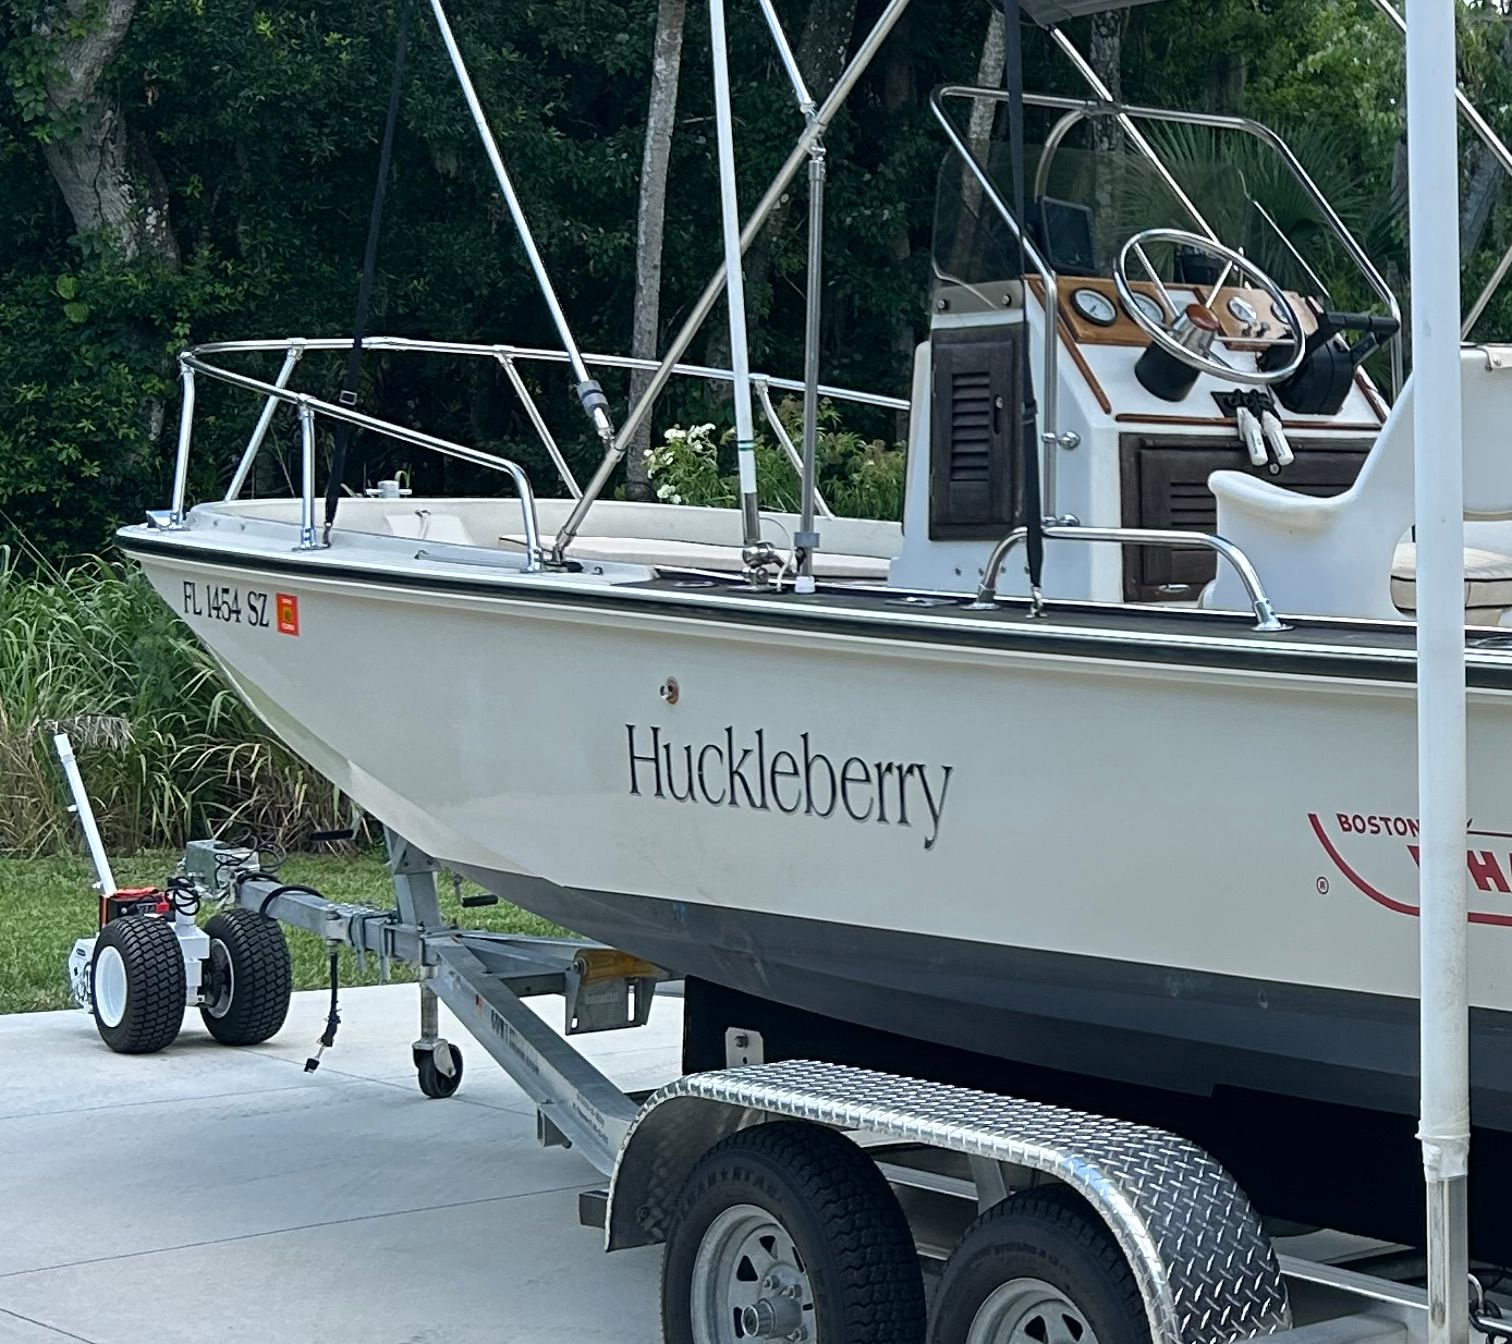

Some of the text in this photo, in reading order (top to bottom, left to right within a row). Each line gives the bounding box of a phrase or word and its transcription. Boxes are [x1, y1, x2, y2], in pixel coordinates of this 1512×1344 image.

[183, 581, 270, 628] FL 1454 SZ
[625, 723, 953, 851] Huckleberry
